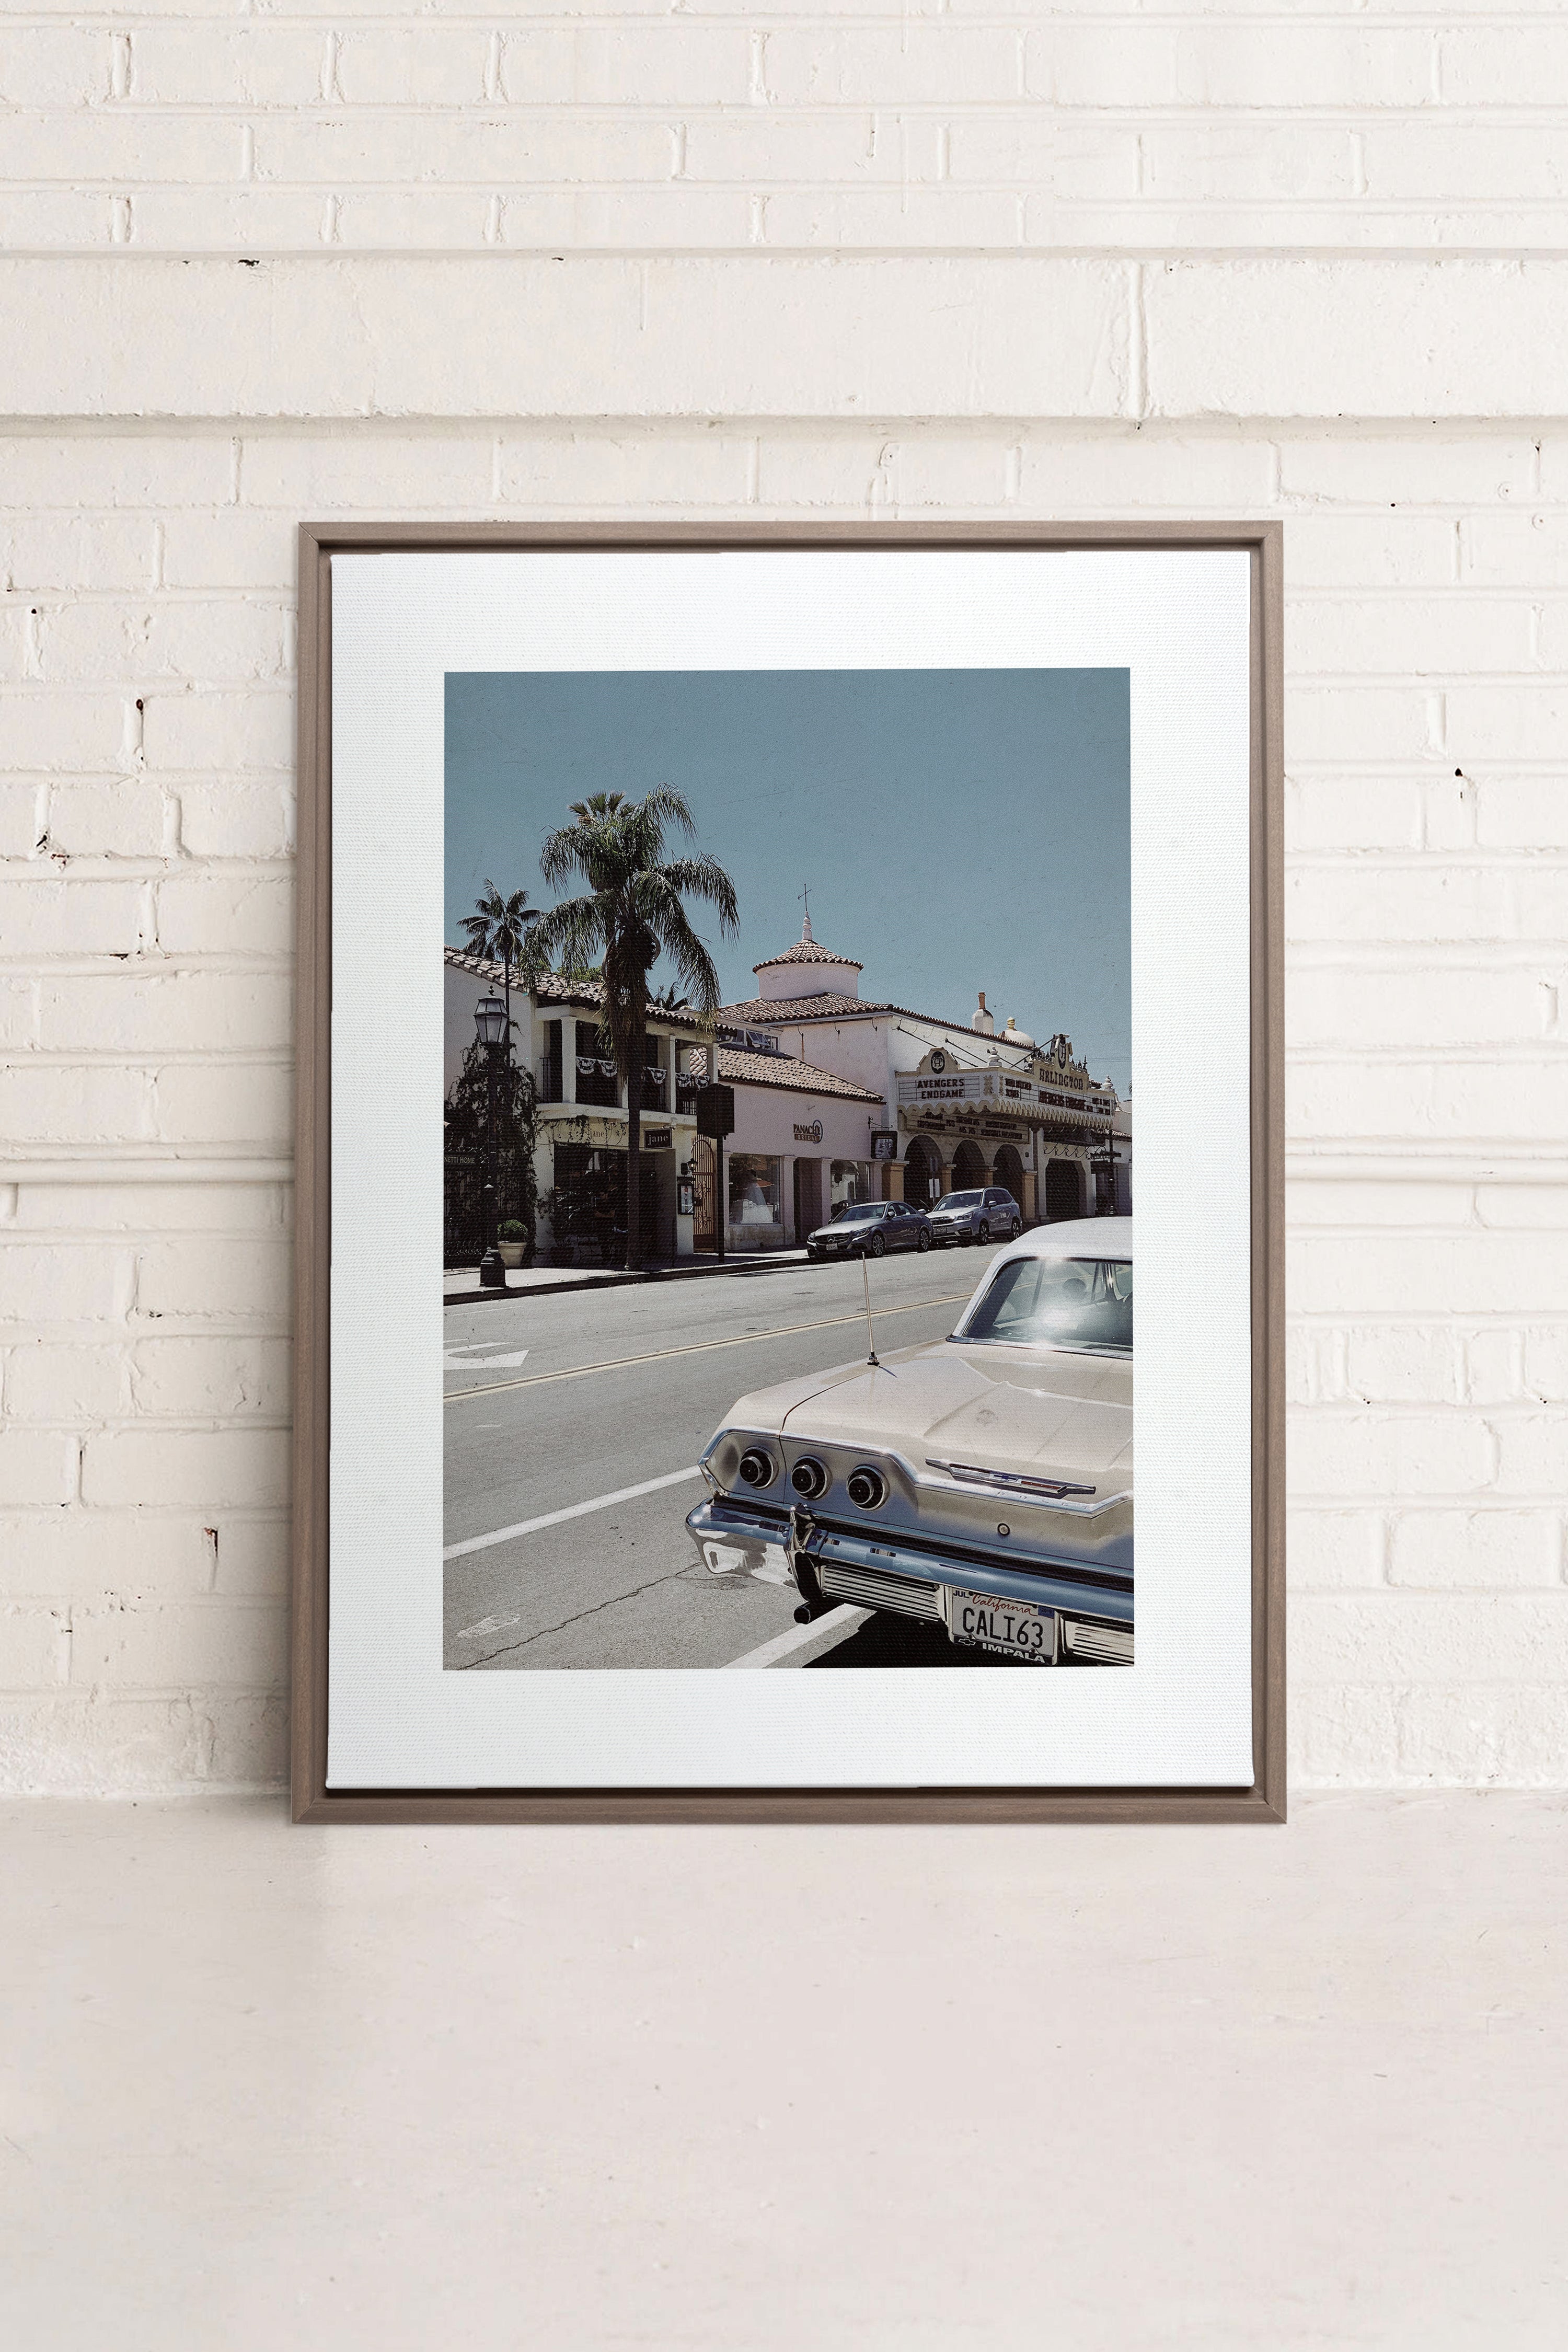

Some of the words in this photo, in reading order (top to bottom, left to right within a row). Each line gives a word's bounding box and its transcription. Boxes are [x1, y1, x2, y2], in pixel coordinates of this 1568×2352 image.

[917, 1078, 964, 1089] AVENGERS
[1039, 1068, 1083, 1091] ARLINGTON
[921, 1089, 964, 1100] ENDGAME
[590, 1128, 605, 1139] jane
[793, 1124, 821, 1136] PANACHE
[648, 1135, 668, 1146] jane
[953, 1590, 970, 1599] JUL
[972, 1594, 1038, 1617] California
[963, 1607, 1043, 1648] CALI63
[982, 1642, 1045, 1664] IMPALA
